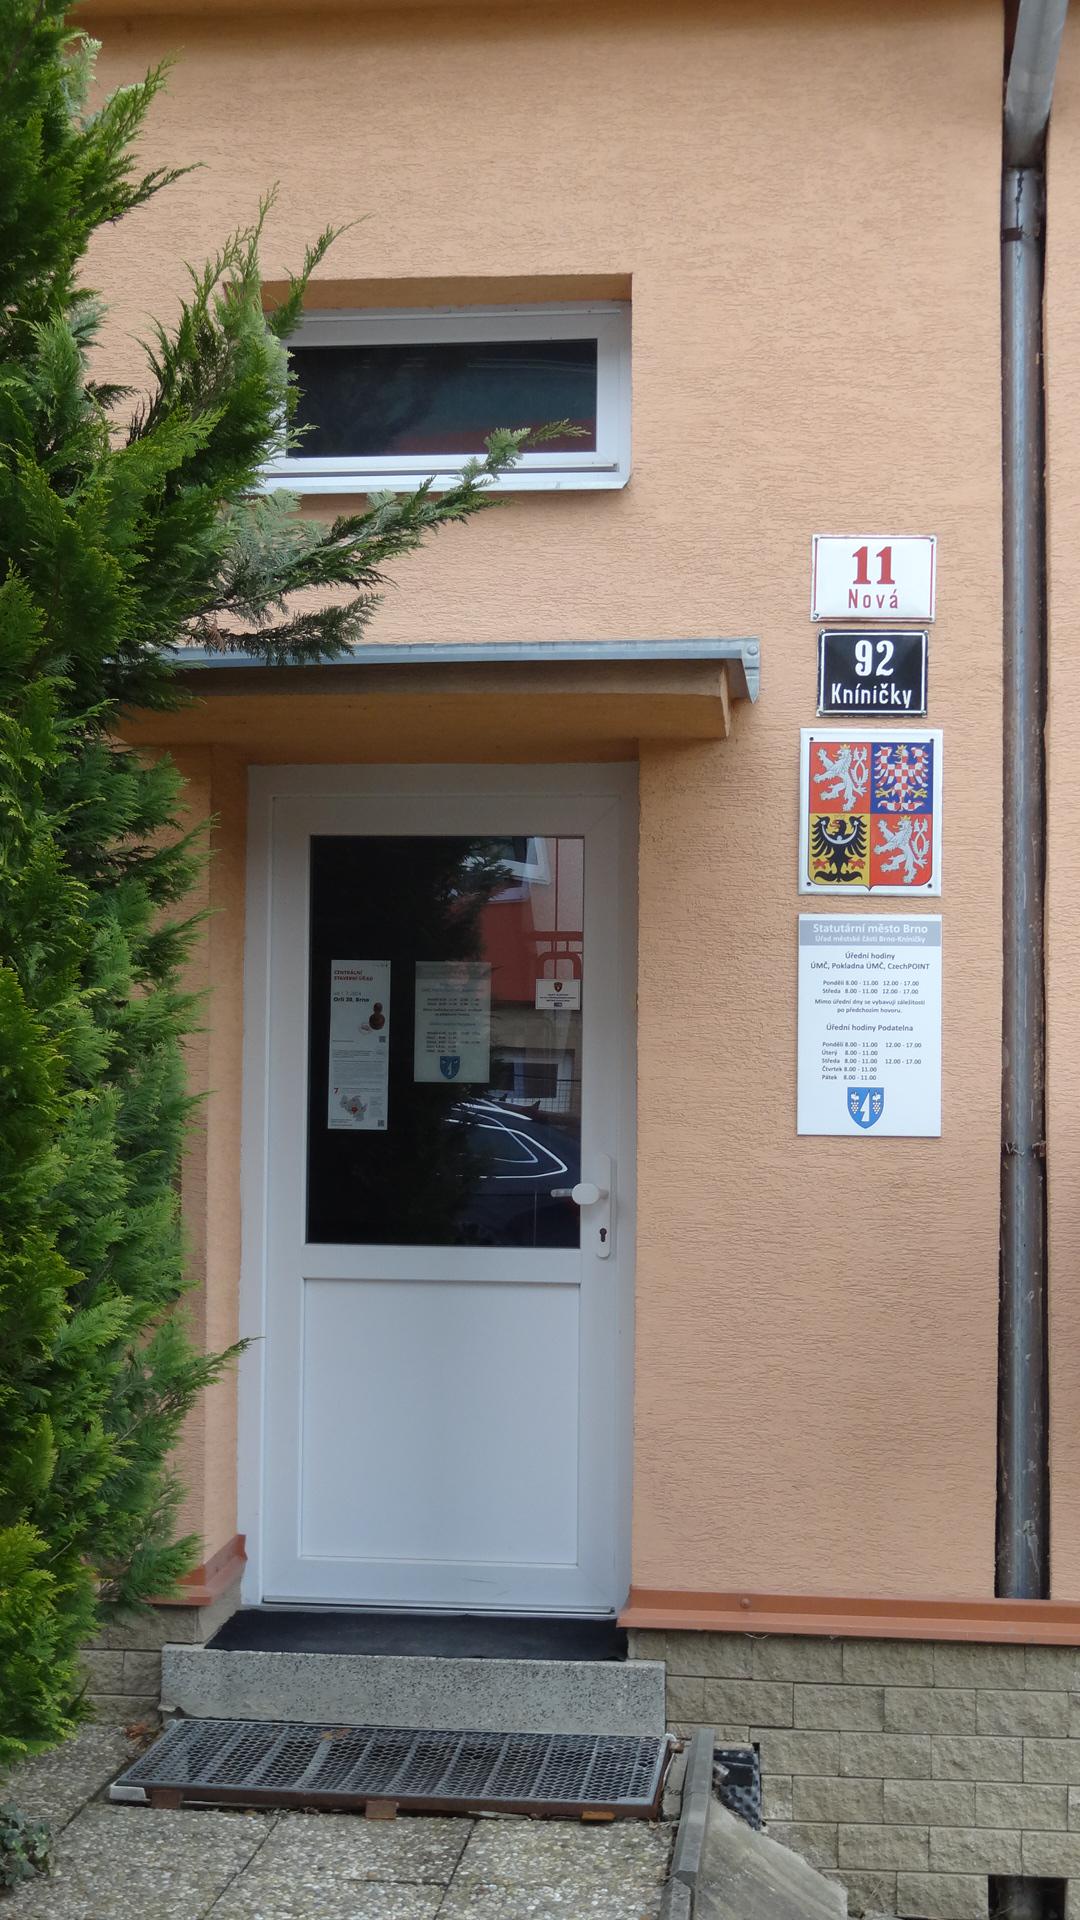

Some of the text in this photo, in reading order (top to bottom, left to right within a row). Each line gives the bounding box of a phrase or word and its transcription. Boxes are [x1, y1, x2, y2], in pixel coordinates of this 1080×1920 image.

[852, 546, 895, 585] 11
[848, 589, 898, 609] Nová
[854, 640, 894, 677] 92
[831, 682, 912, 709] Kníničky
[813, 923, 928, 934] Statutární město Brno
[810, 962, 830, 970] ÚMČ,
[852, 1024, 876, 1032] hodiny
